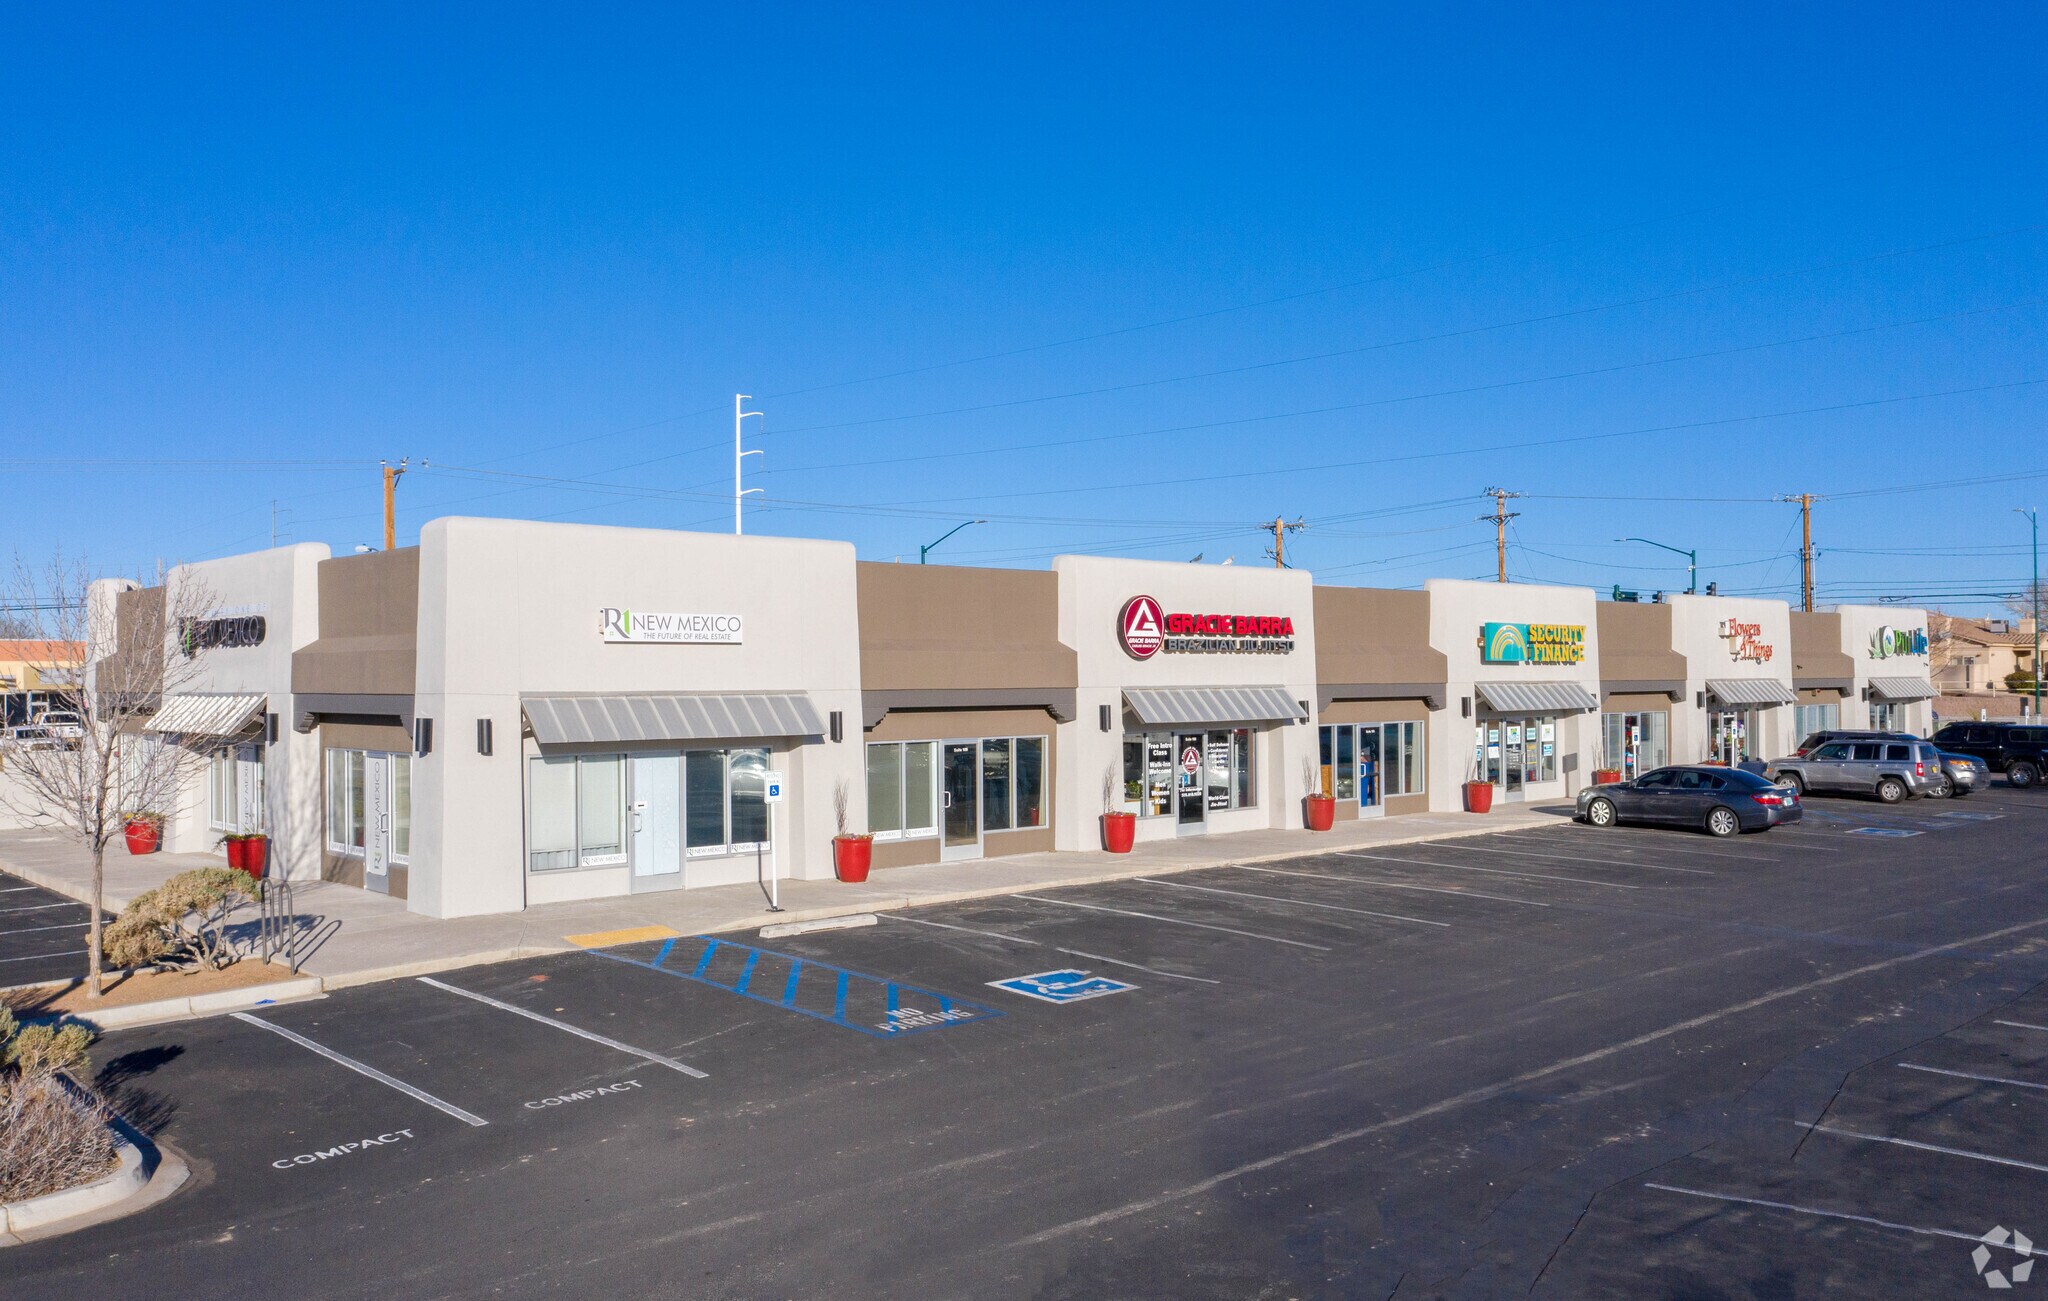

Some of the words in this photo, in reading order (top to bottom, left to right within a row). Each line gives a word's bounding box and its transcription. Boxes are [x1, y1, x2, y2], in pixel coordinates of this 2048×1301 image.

[219, 615, 259, 645] MEXICO
[632, 615, 673, 631] NEW
[677, 616, 741, 632] MEXICO
[1168, 613, 1232, 634] GRACIE
[1235, 615, 1295, 635] BARRA
[657, 632, 682, 640] FUTURE
[1530, 624, 1586, 642] SECURITY
[1168, 639, 1237, 651] BRAZILIAN
[1534, 644, 1585, 662] FINANCE
[524, 1079, 643, 1110] COMPACT
[272, 1128, 416, 1170] COMPACT
